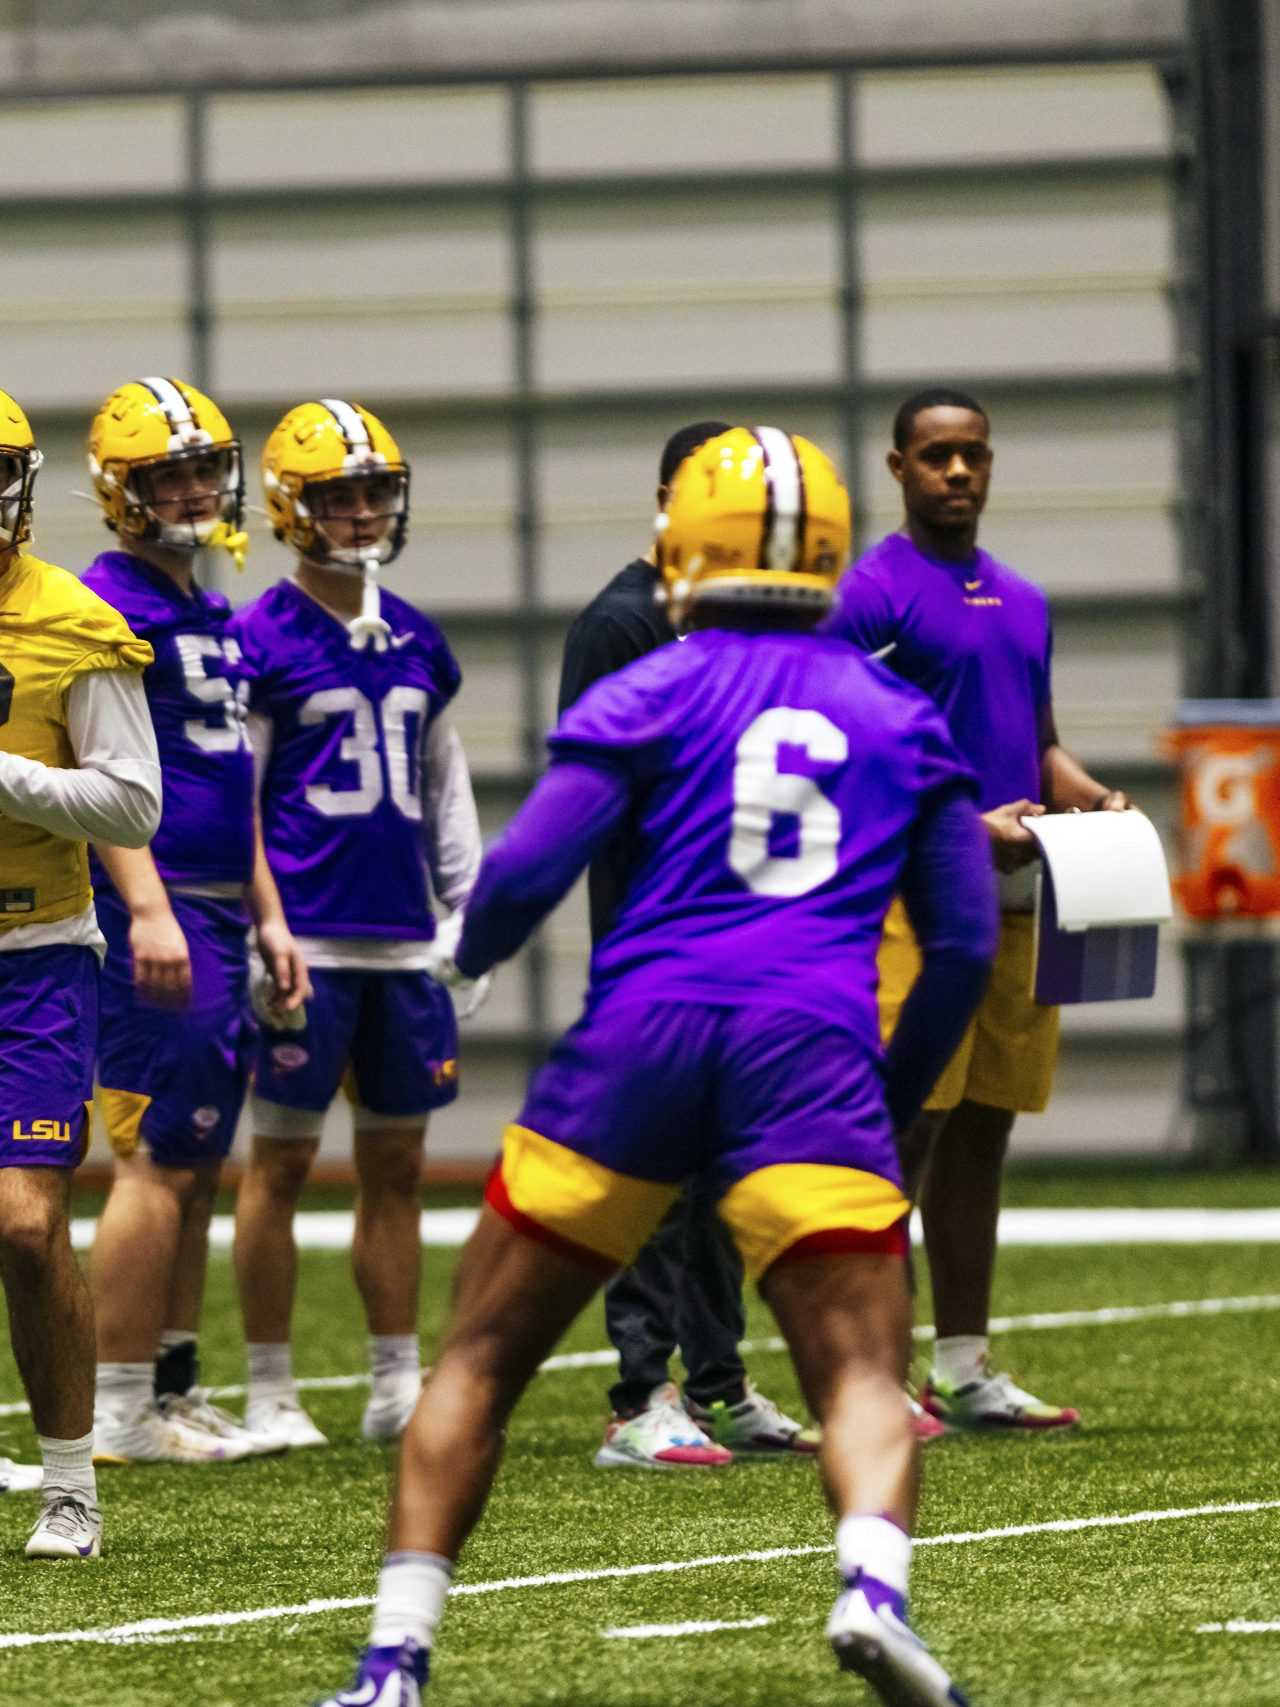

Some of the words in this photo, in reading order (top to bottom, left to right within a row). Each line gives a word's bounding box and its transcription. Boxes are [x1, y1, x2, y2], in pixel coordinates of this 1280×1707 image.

[299, 686, 423, 820] 30
[727, 706, 848, 898] 6
[12, 1119, 71, 1142] LSU
